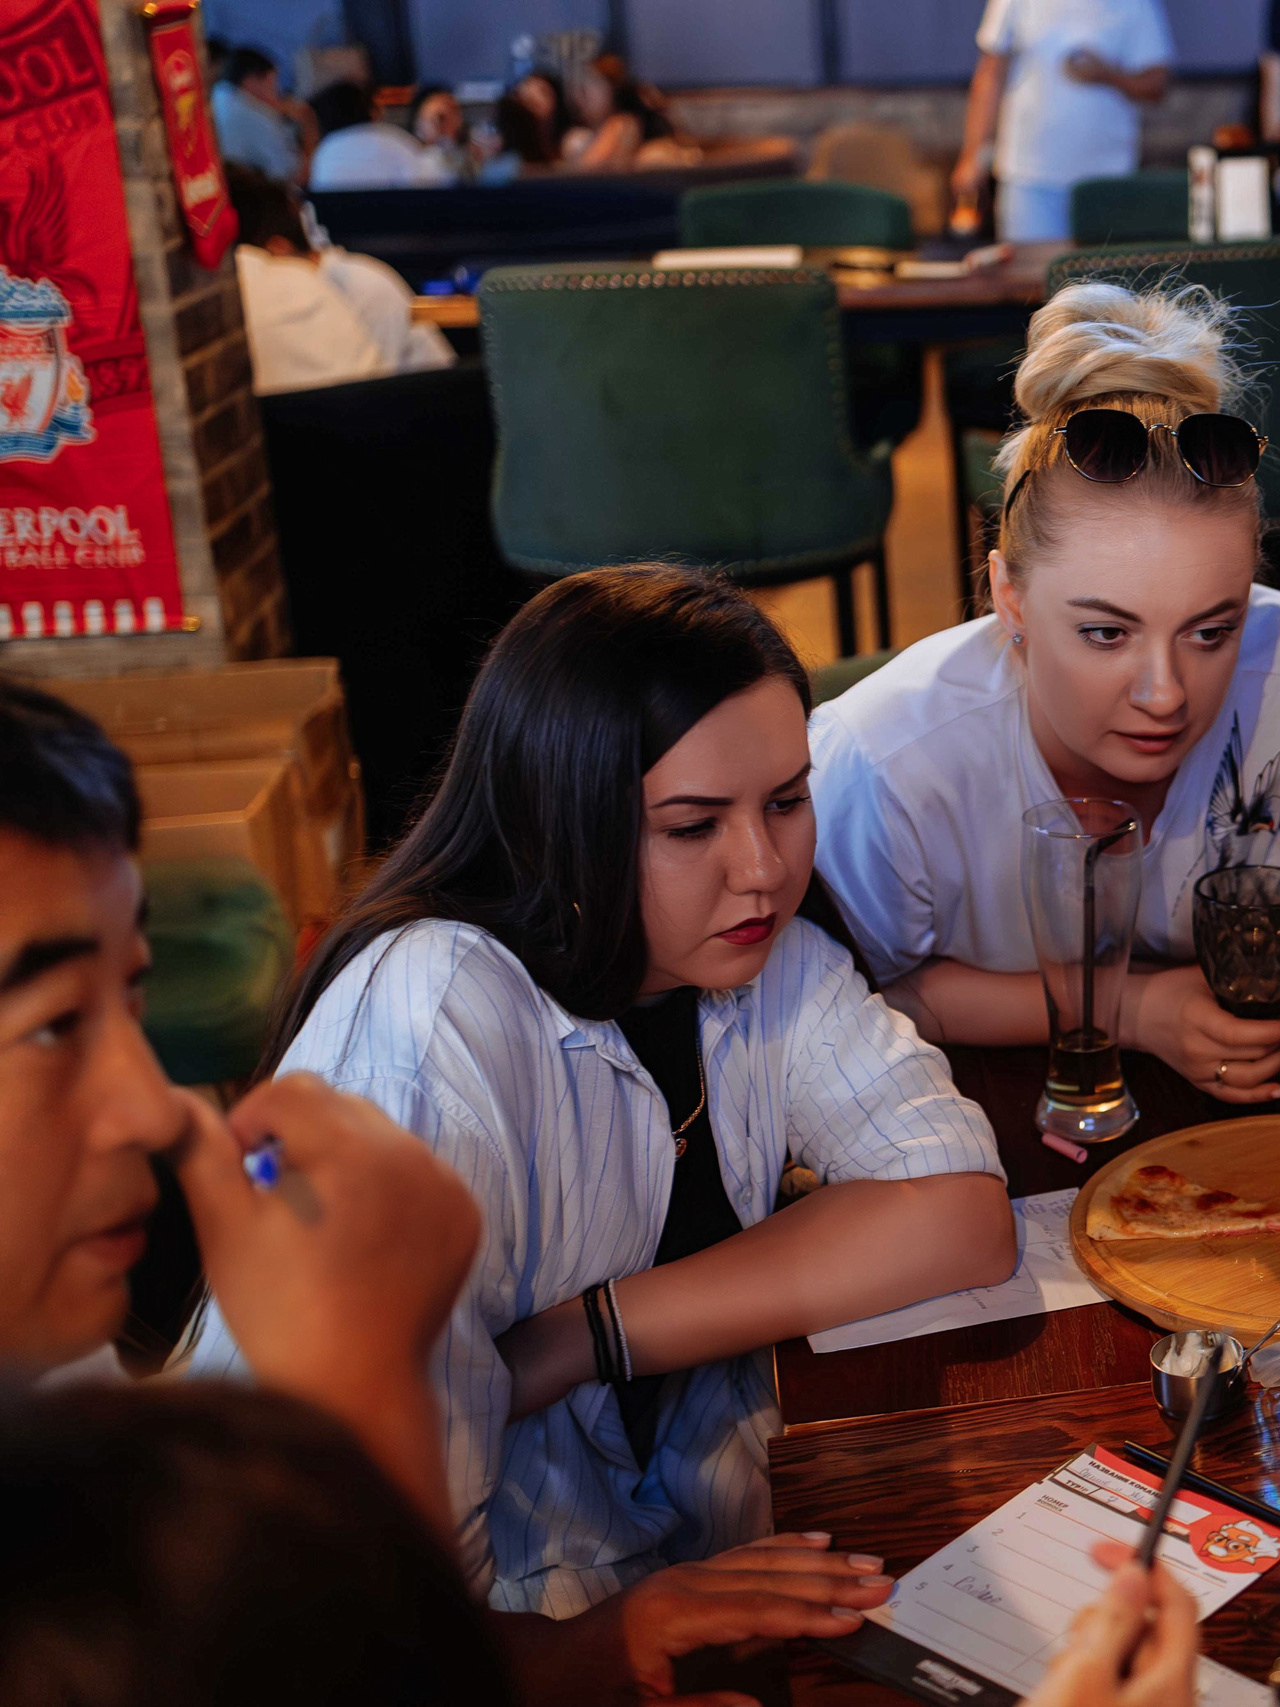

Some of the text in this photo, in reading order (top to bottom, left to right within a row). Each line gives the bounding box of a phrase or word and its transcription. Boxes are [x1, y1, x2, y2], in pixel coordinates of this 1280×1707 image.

[1066, 1479, 1081, 1489] ТУР
[1088, 1461, 1129, 1484] НАЗВАНИЕ
[1129, 1481, 1162, 1499] КОМАН
[1041, 1494, 1069, 1508] НОМЕР
[1016, 1512, 1027, 1520] 1
[991, 1528, 1004, 1537] 2
[914, 1581, 928, 1591] 5
